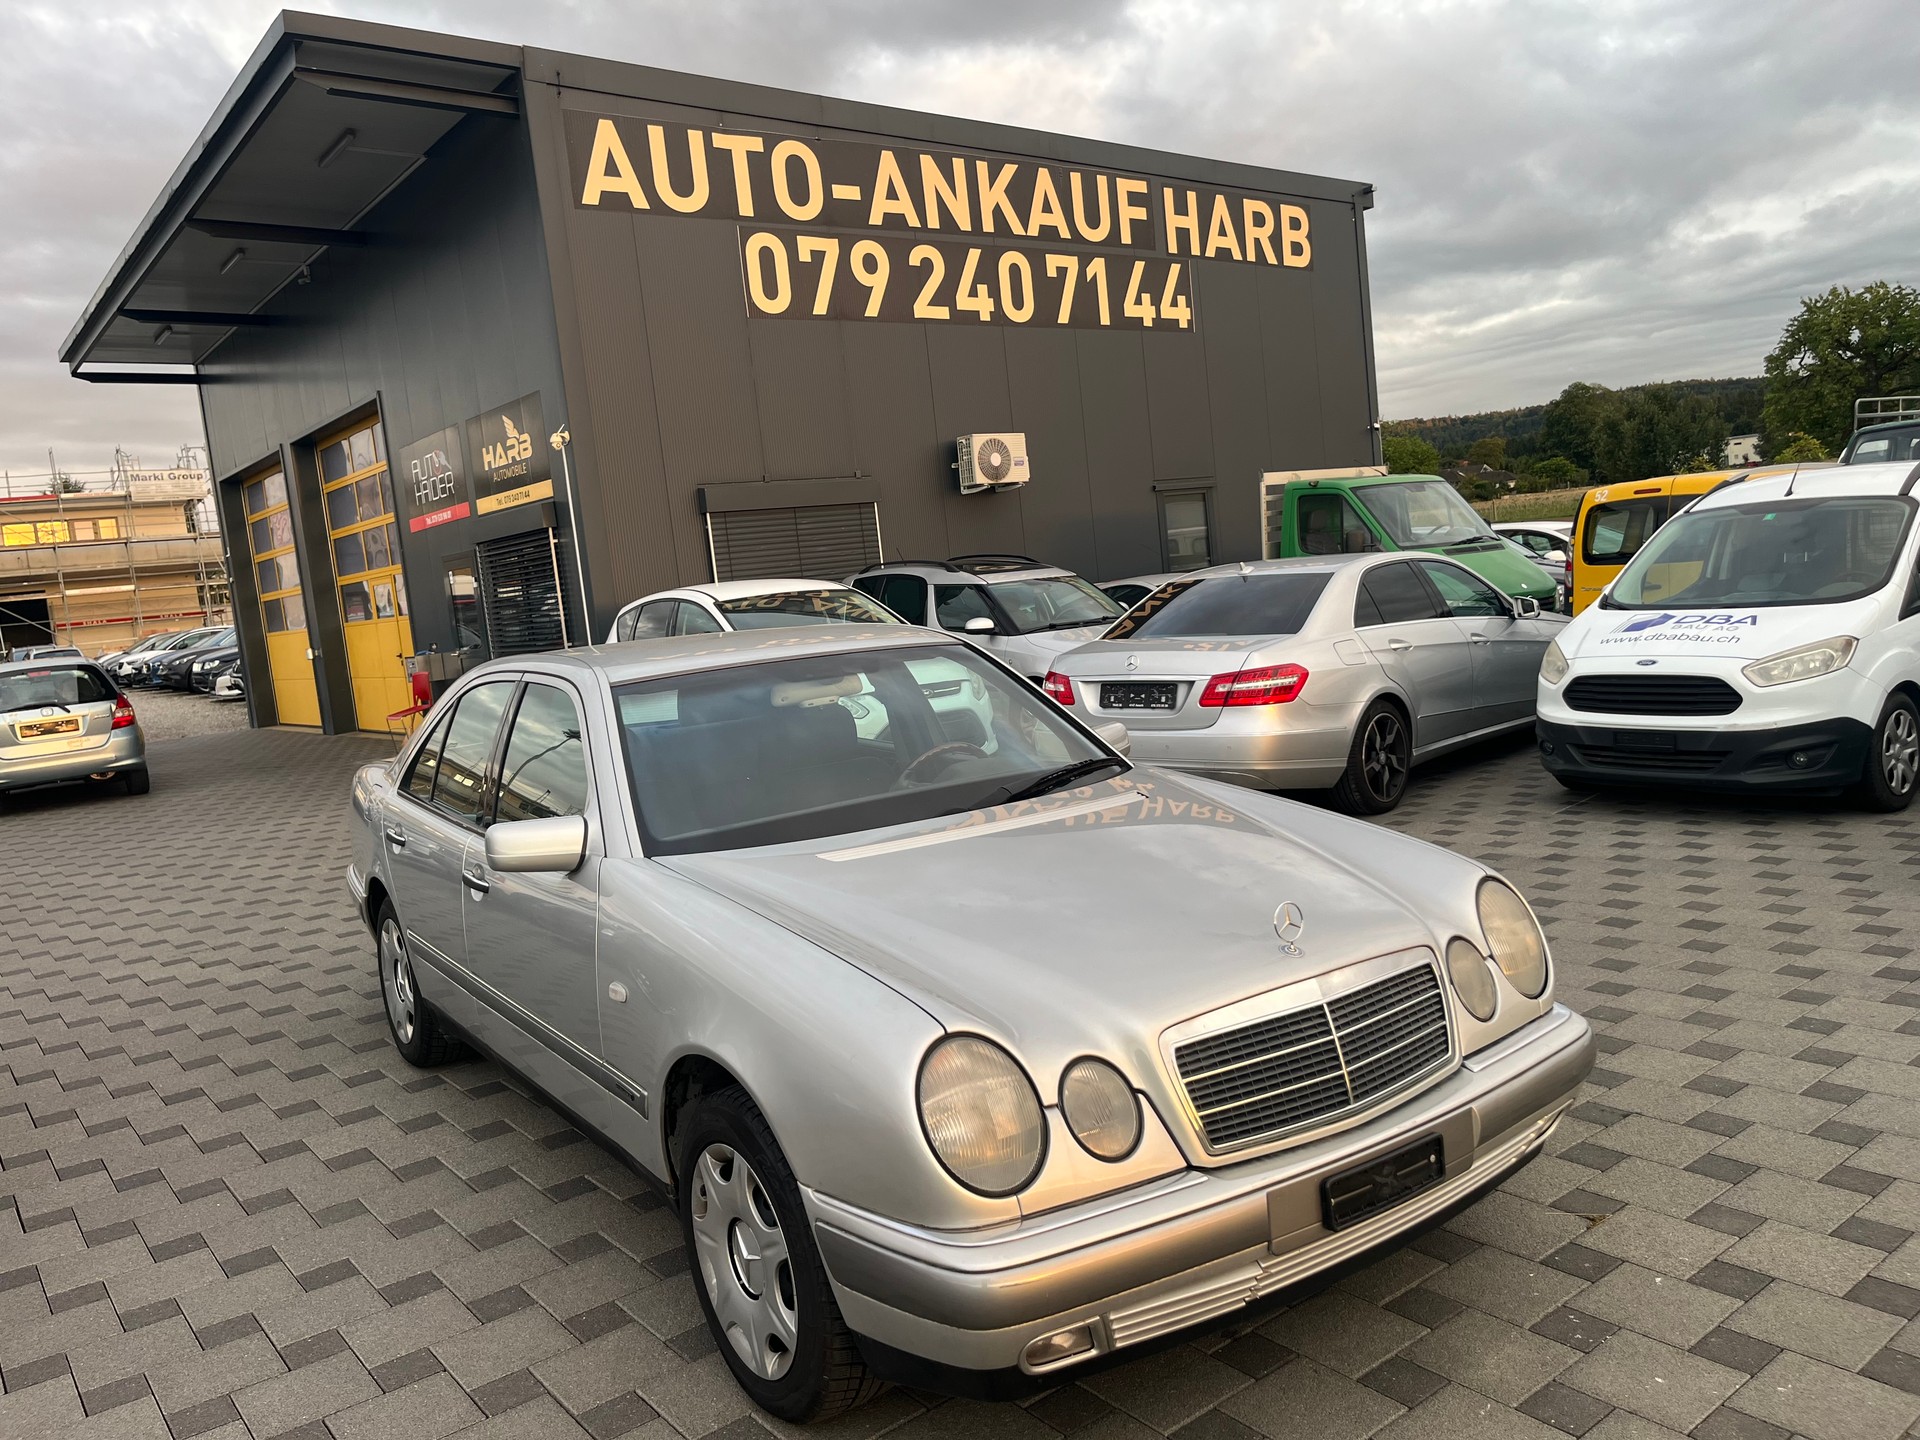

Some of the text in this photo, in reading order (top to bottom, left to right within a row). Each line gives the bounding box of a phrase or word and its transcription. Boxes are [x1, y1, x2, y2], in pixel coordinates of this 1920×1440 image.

[581, 118, 1311, 269] AUTO-ANKAUF HARB
[745, 232, 890, 317] 079
[482, 433, 533, 471] HARB
[168, 472, 204, 481] Group
[493, 462, 528, 482] AUTOMOBILE
[1594, 489, 1608, 502] 52
[1673, 614, 1758, 626] DBA
[1600, 632, 1741, 645] www.dbabau.ch
